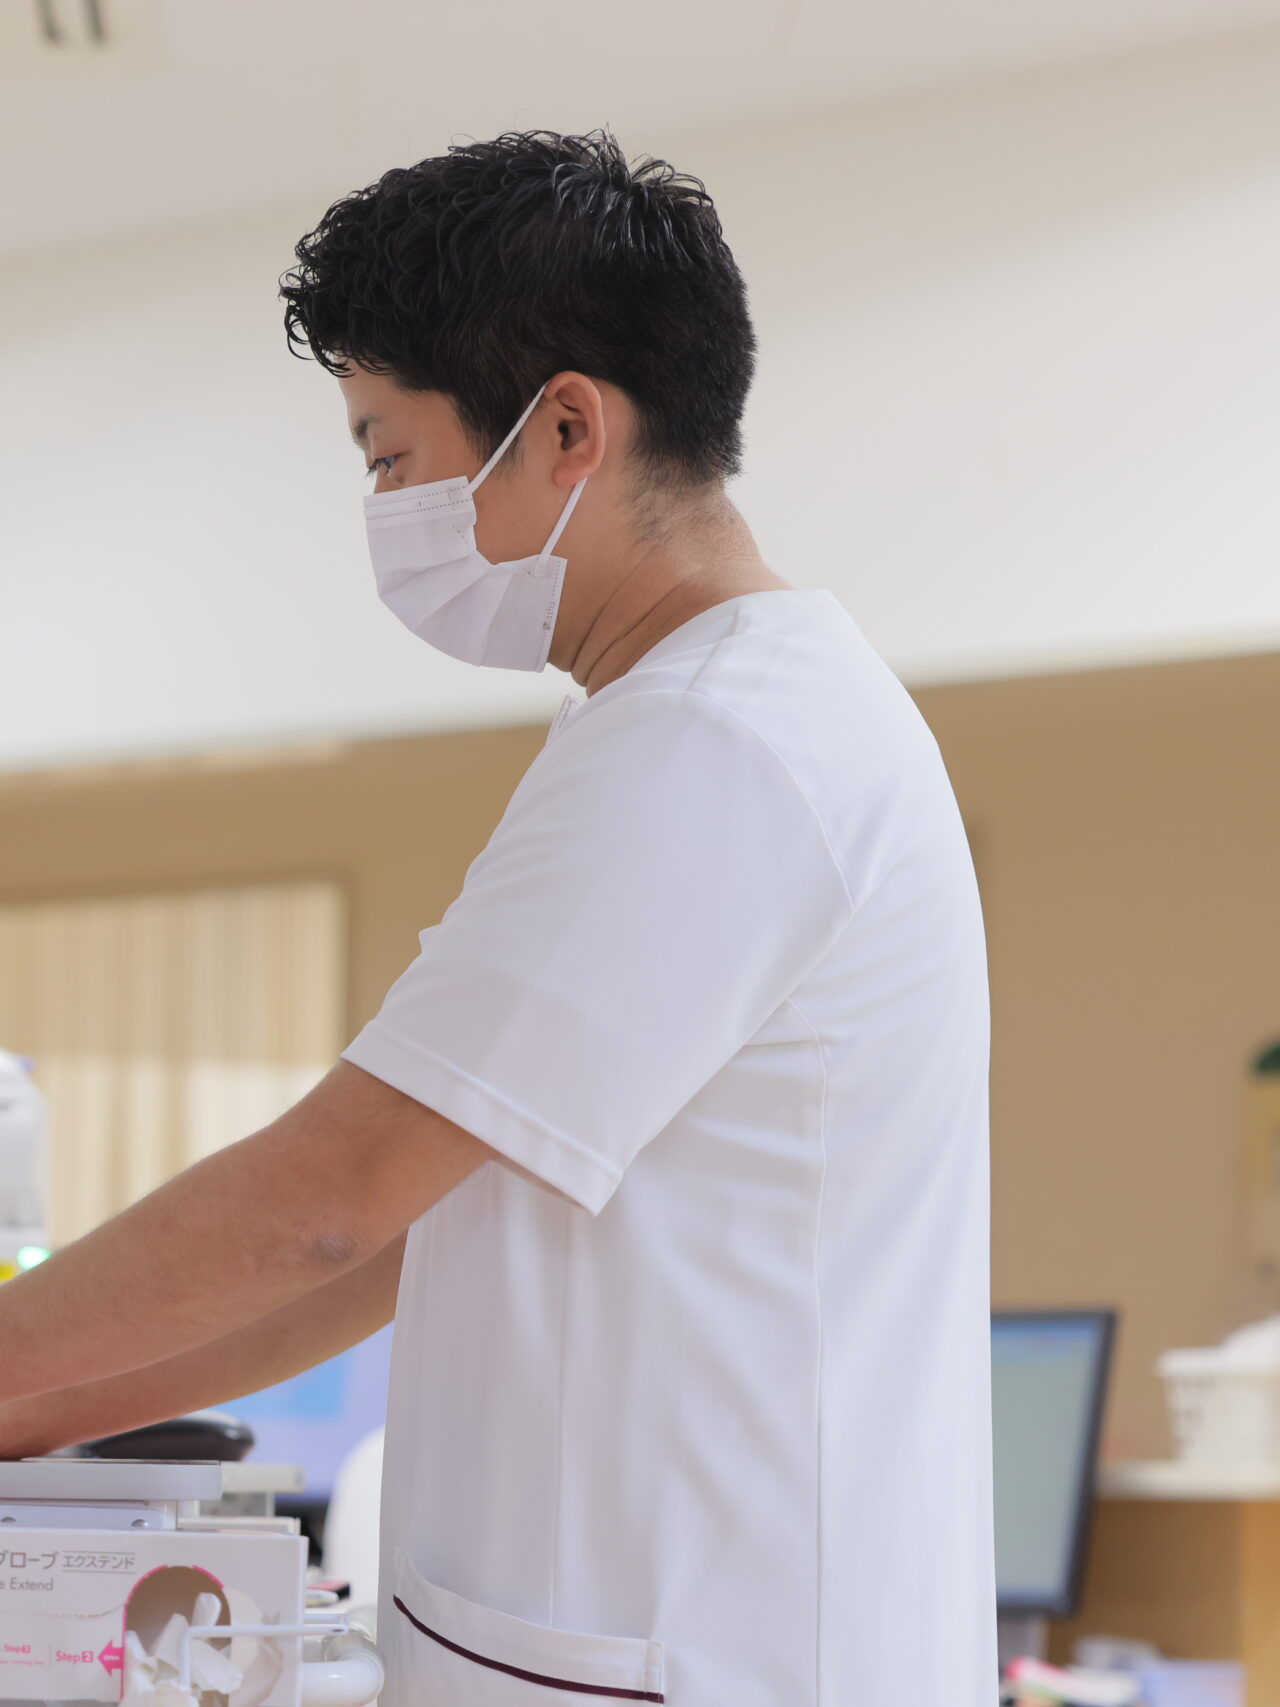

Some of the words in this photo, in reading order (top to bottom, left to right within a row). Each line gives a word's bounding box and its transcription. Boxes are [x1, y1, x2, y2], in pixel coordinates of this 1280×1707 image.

[63, 1554, 136, 1570] エクステンド
[10, 1576, 54, 1592] Extend
